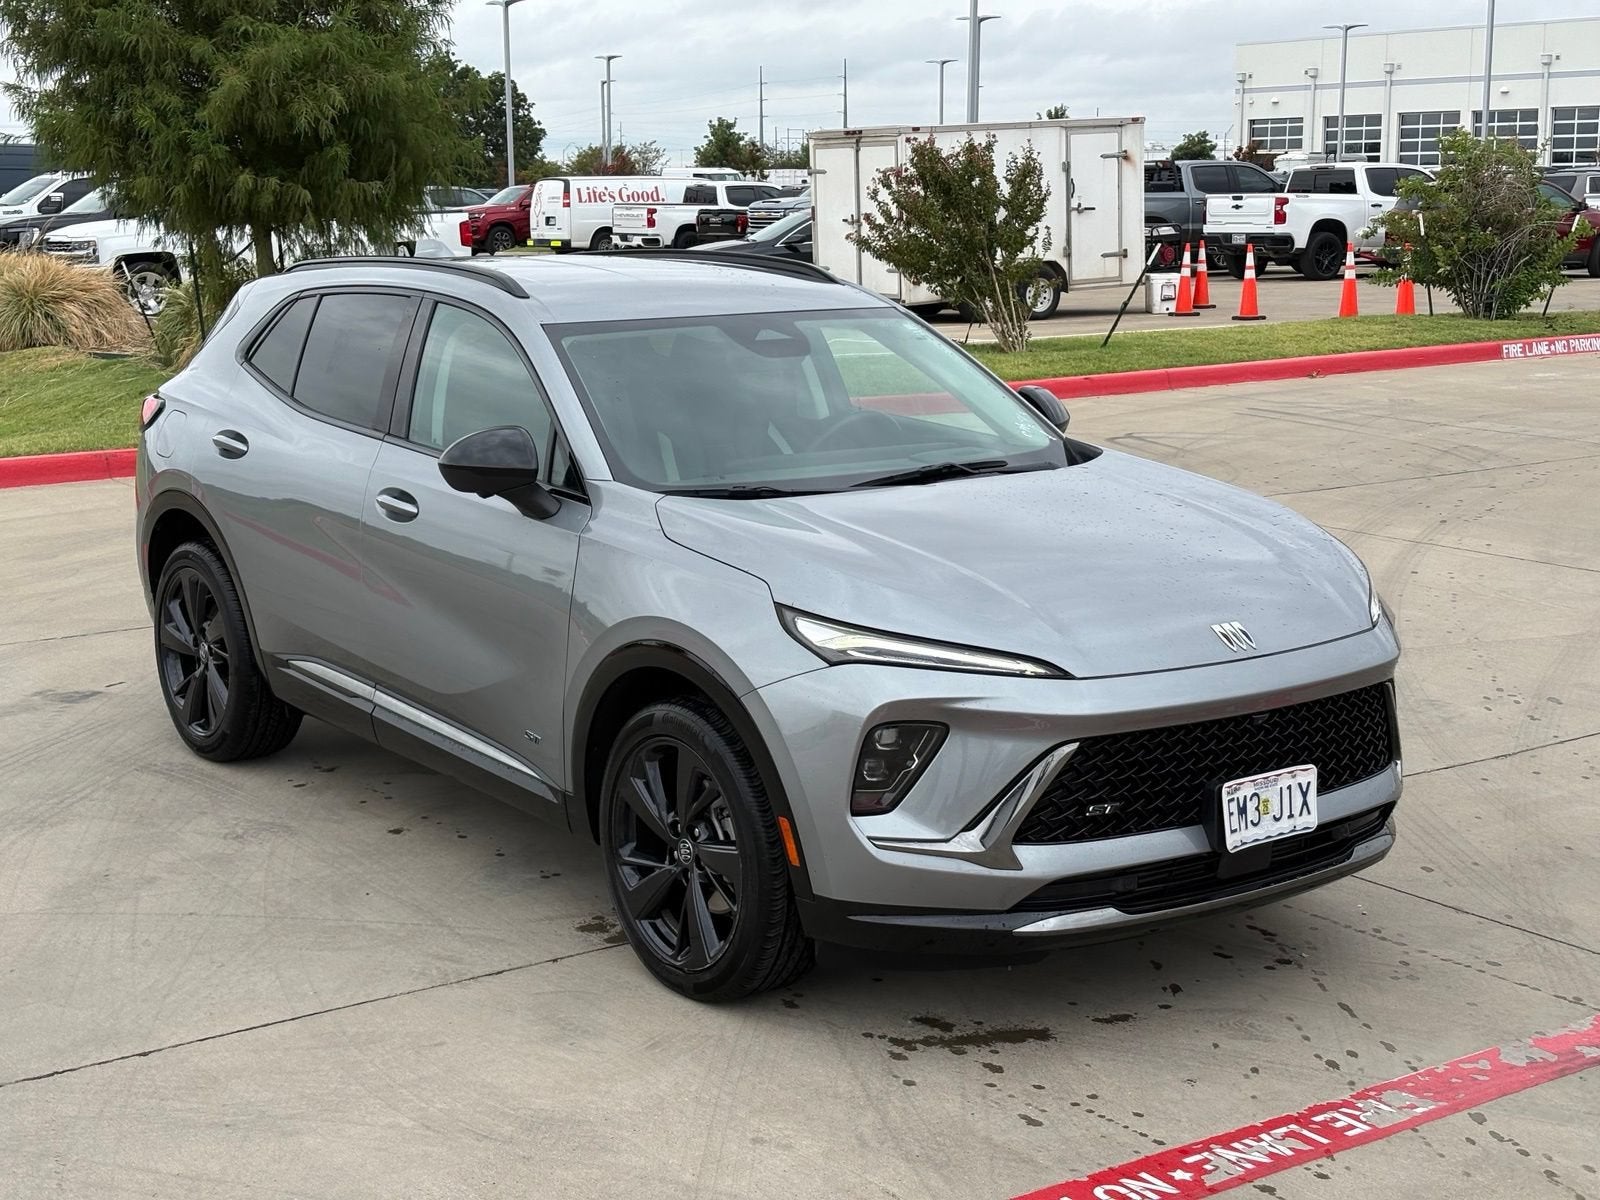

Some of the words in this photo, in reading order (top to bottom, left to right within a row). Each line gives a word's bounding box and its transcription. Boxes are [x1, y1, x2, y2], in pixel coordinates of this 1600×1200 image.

[576, 186, 616, 204] Life's
[618, 185, 666, 203] Good.
[1502, 343, 1525, 358] FIRE
[1525, 341, 1551, 356] LANE
[1554, 340, 1568, 353] NO
[1227, 792, 1261, 835] EM3
[1272, 781, 1312, 822] J1X
